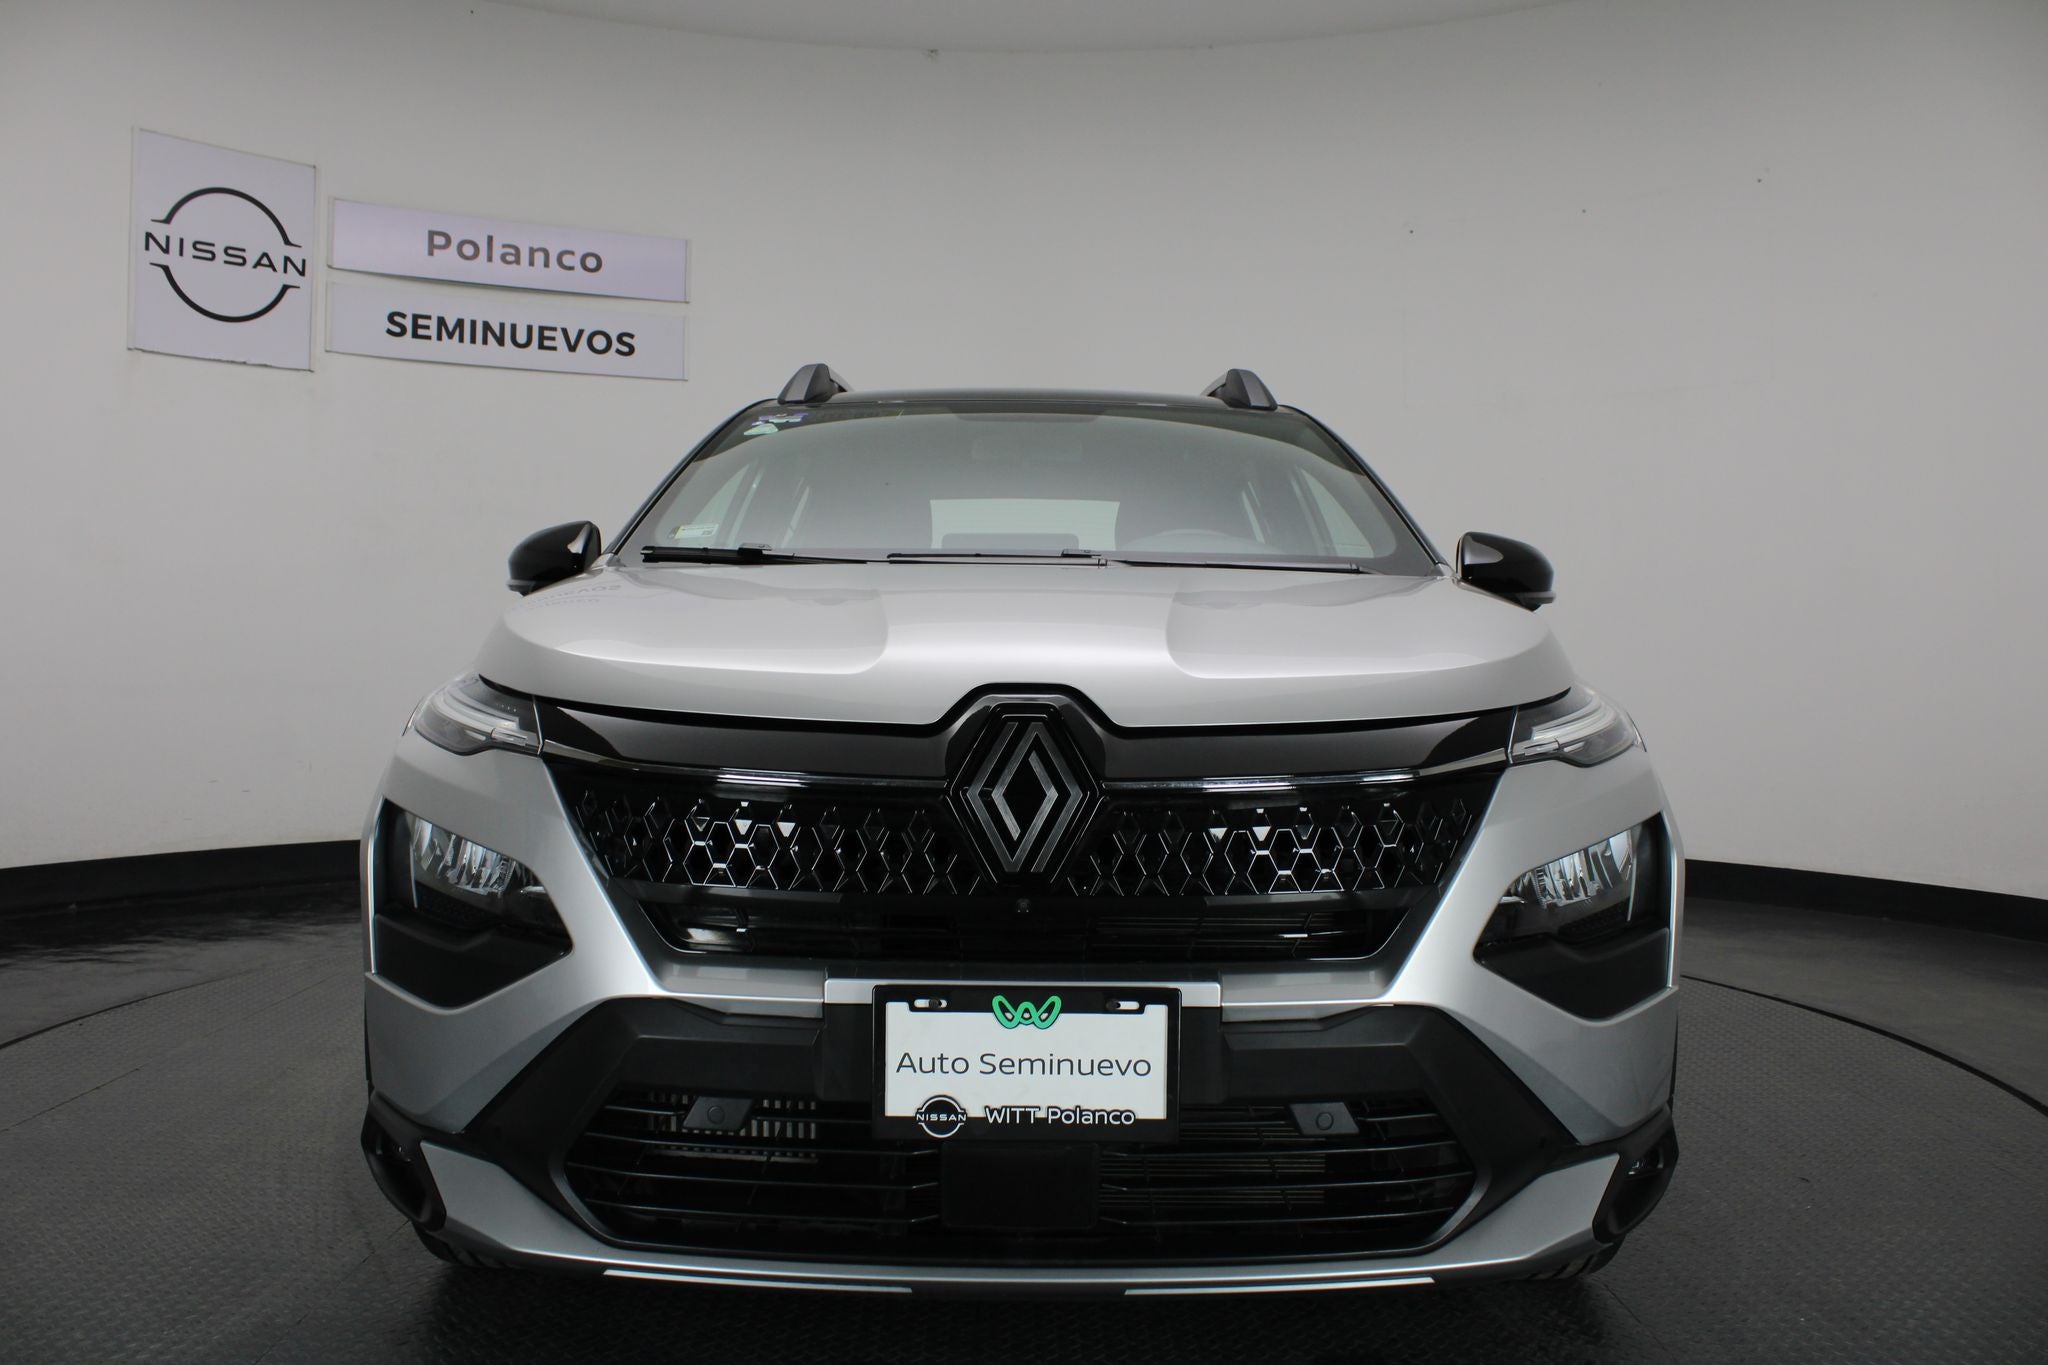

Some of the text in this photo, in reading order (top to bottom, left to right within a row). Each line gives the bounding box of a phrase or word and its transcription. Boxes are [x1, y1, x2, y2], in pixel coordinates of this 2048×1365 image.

[144, 231, 306, 277] NISSAN
[427, 229, 603, 273] Polanco
[385, 311, 636, 357] SEMINUEVOS
[895, 1052, 1151, 1076] Auto Seminuevo
[915, 1112, 967, 1123] NISSAN
[986, 1106, 1136, 1125] WITT Polanco
